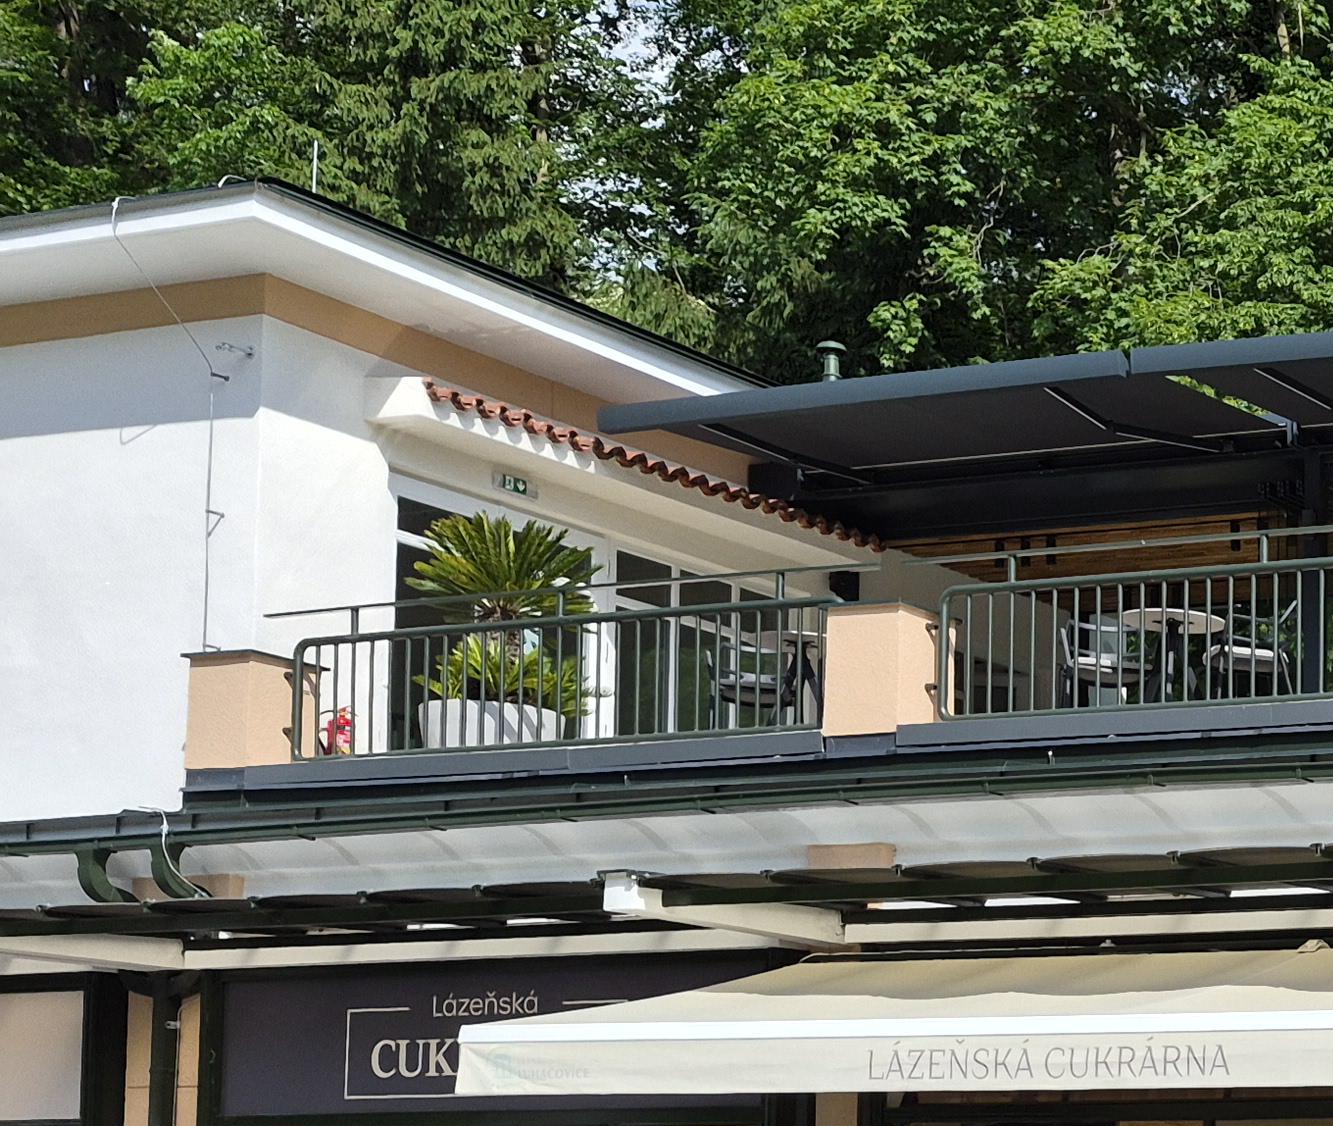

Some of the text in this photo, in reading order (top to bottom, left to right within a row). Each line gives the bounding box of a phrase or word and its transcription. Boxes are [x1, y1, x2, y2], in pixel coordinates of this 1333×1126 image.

[432, 989, 539, 1018] Lázeňská
[371, 1038, 458, 1079] CUK
[867, 1036, 1231, 1081] LÁZEŇSKÁ CUKRÁRNA
